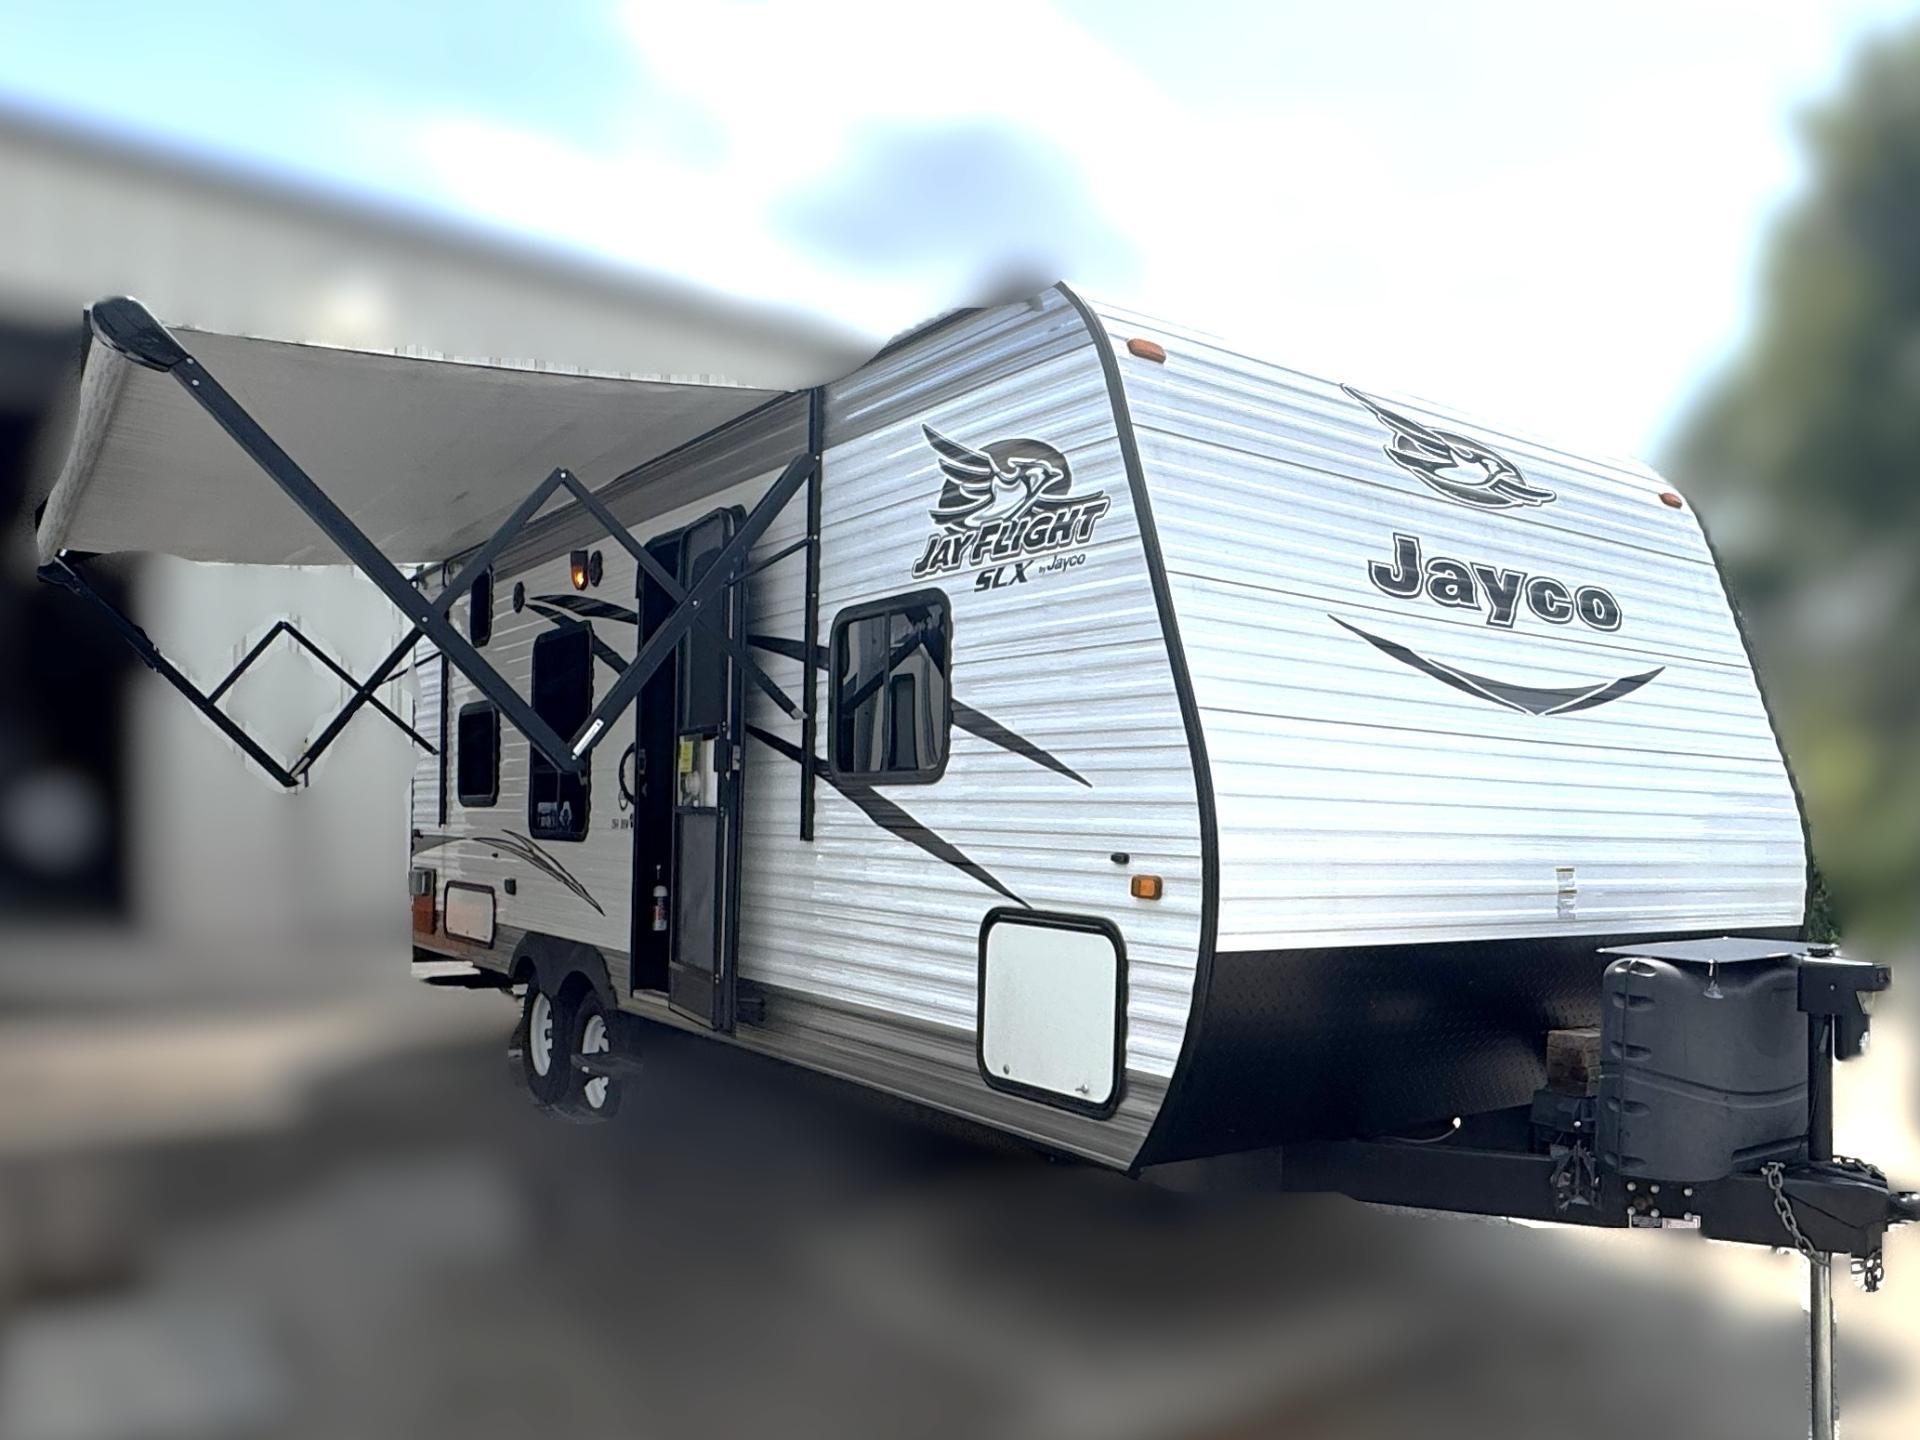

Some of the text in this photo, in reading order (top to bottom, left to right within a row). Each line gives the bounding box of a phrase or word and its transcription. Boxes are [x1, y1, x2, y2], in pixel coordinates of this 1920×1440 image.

[974, 560, 1034, 592] SLX
[1046, 553, 1086, 572] Jayco
[1368, 532, 1623, 632] Jayco
